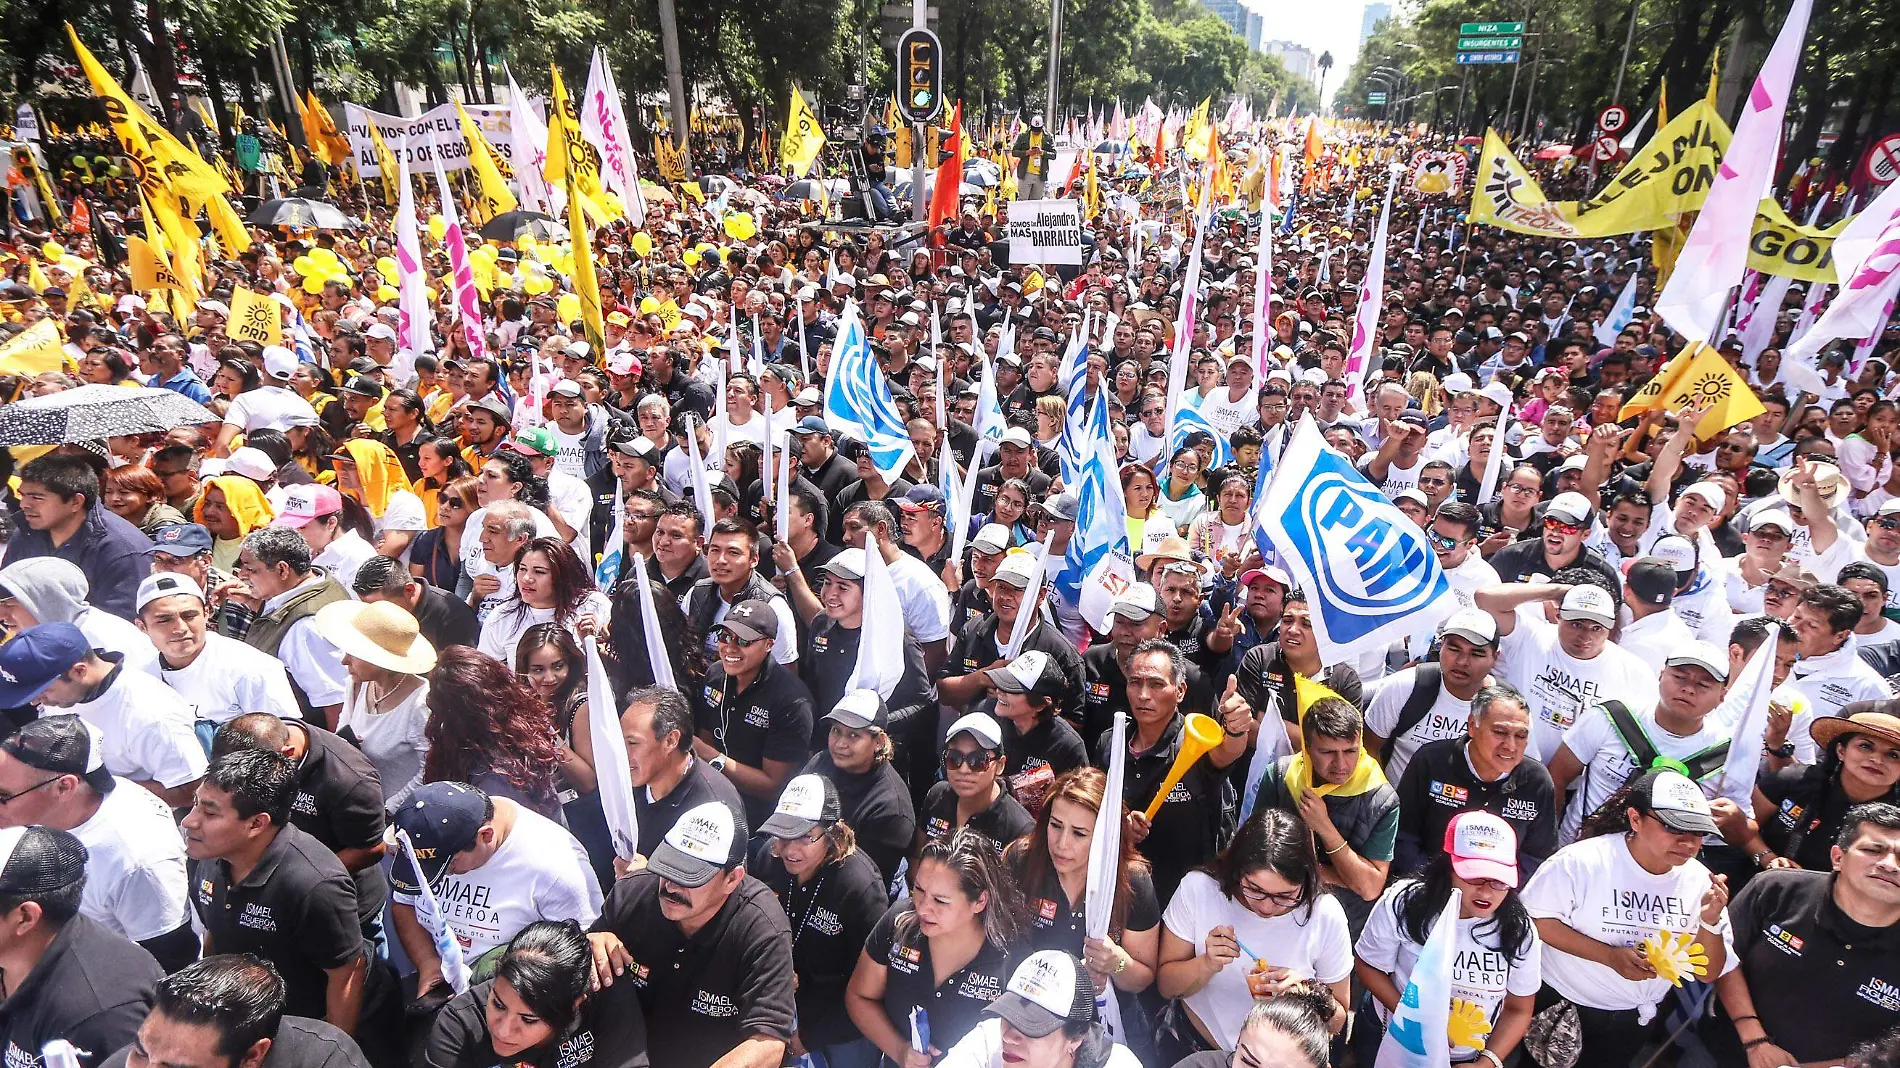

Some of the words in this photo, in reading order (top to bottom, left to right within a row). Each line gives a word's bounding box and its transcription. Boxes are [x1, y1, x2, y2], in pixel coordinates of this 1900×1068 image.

[352, 124, 405, 139] “VMOS
[436, 118, 452, 131] EL
[1036, 211, 1076, 228] Alejandra
[1010, 228, 1031, 238] MAS
[1031, 230, 1079, 247] BARRALES
[239, 325, 269, 342] PRD
[1319, 489, 1425, 598] PAN
[1545, 664, 1602, 698] ISMAEL
[751, 705, 770, 719] ISMAEL
[1424, 711, 1469, 732] ISMA
[1507, 797, 1535, 811] ISMAEL
[691, 817, 720, 833] ISMAEL
[414, 848, 437, 859] NY
[246, 902, 272, 919] ISMAEL
[1613, 889, 1690, 917] ISMAEL
[240, 913, 277, 928] FIGUEROA
[816, 906, 840, 926] ISMAEL
[1601, 906, 1699, 929] FIGUERO
[968, 972, 1000, 990] ISMAEL
[1870, 977, 1900, 1000] ISMA
[692, 999, 738, 1013] FIGUEROA
[698, 990, 732, 1006] ISMAEL
[8, 1040, 38, 1065] ISMAEL
[558, 1030, 594, 1058] ISMAE
